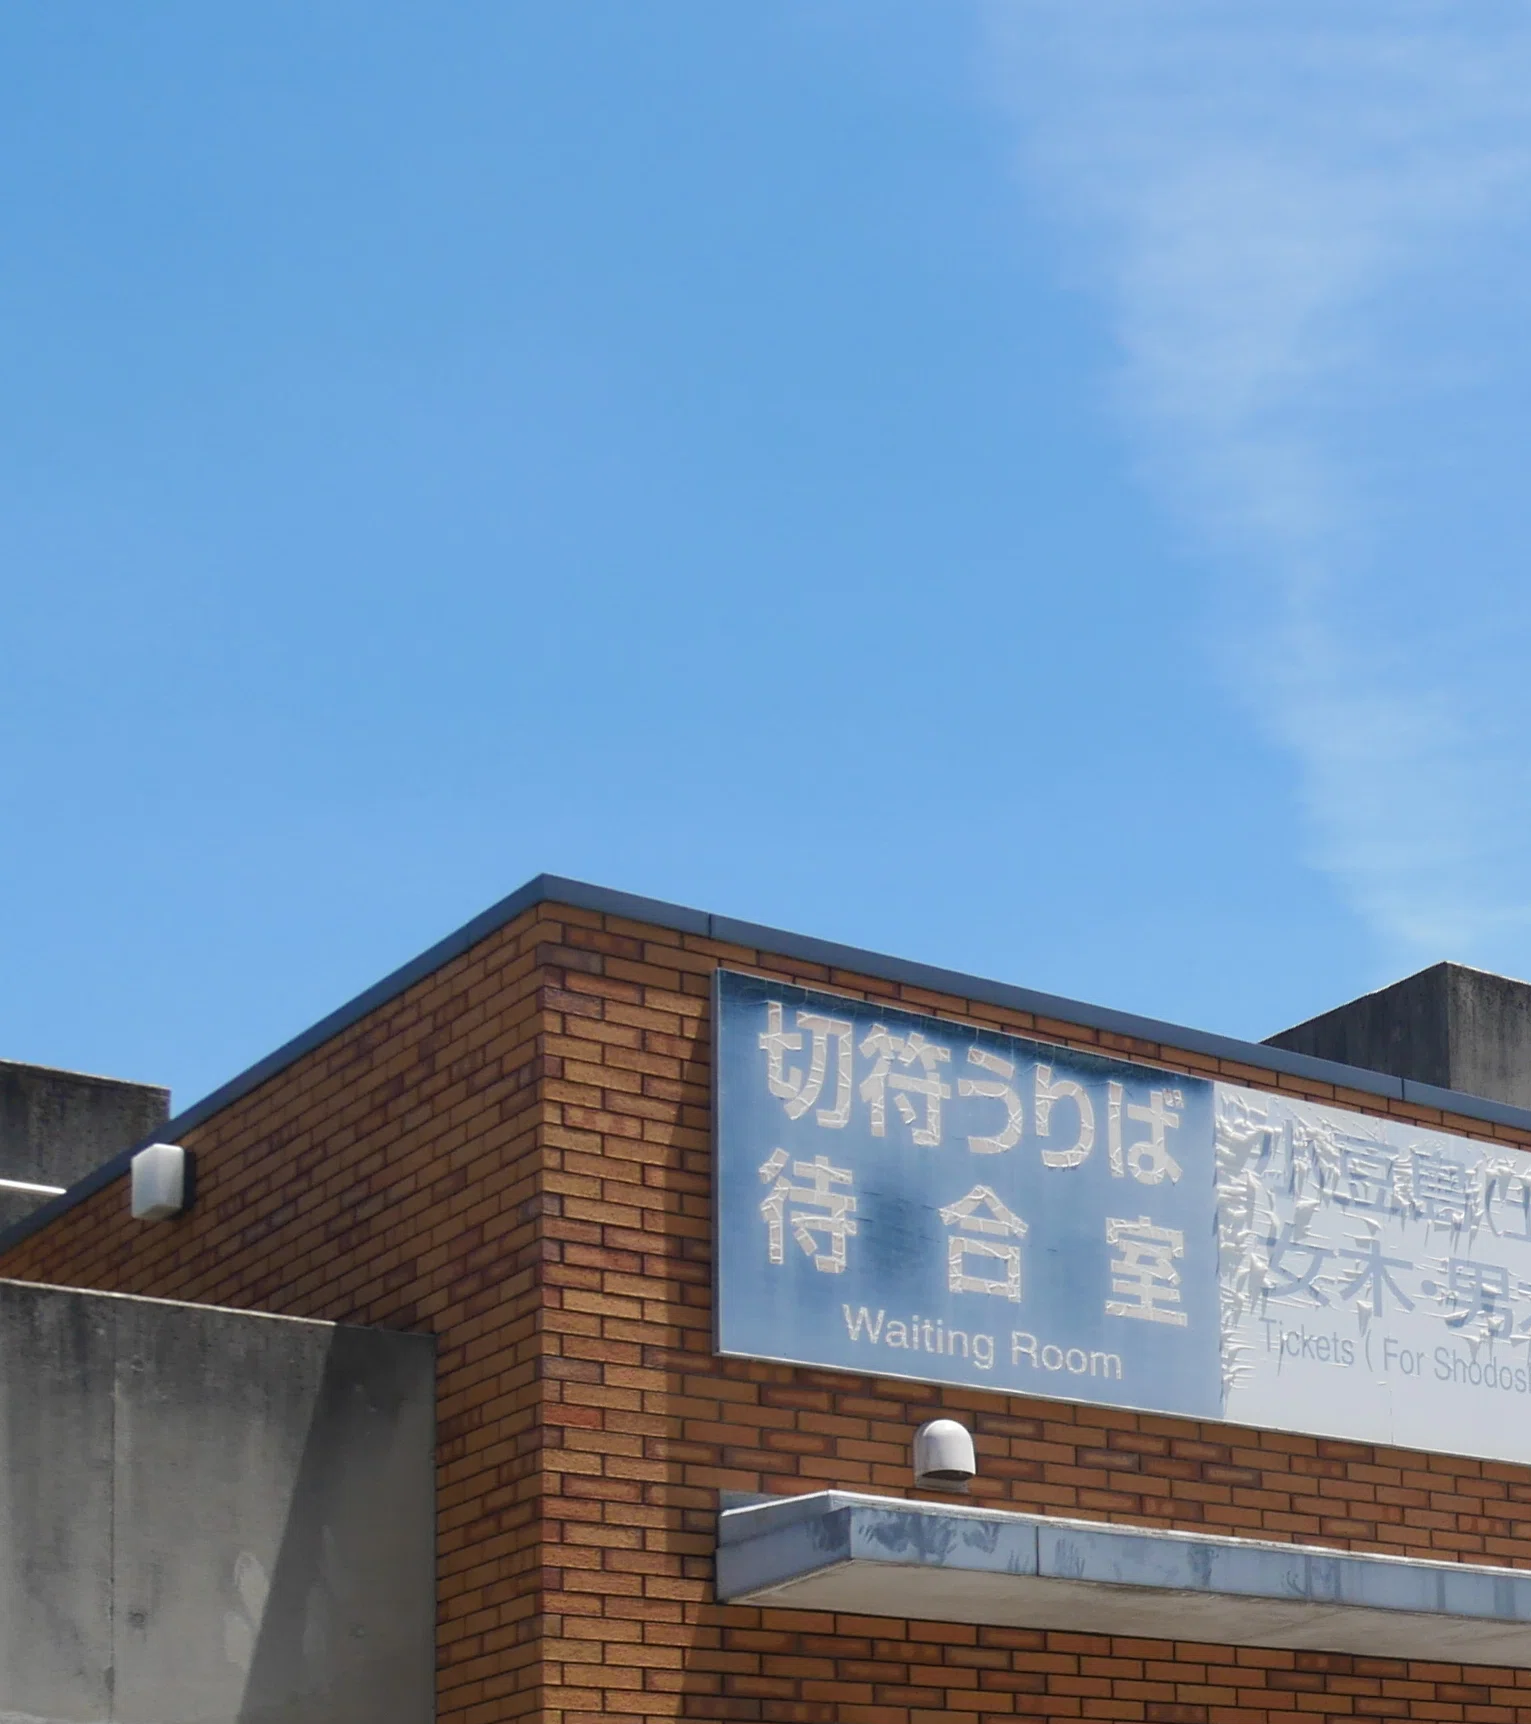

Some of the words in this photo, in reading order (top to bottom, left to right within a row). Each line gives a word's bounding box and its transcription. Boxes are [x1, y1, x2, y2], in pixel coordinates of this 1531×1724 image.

[758, 1000, 1186, 1184] 切符うりば
[842, 1303, 995, 1371] Waiting
[1010, 1331, 1124, 1381] Room
[1258, 1316, 1355, 1365] Tickets
[1383, 1336, 1424, 1377] For
